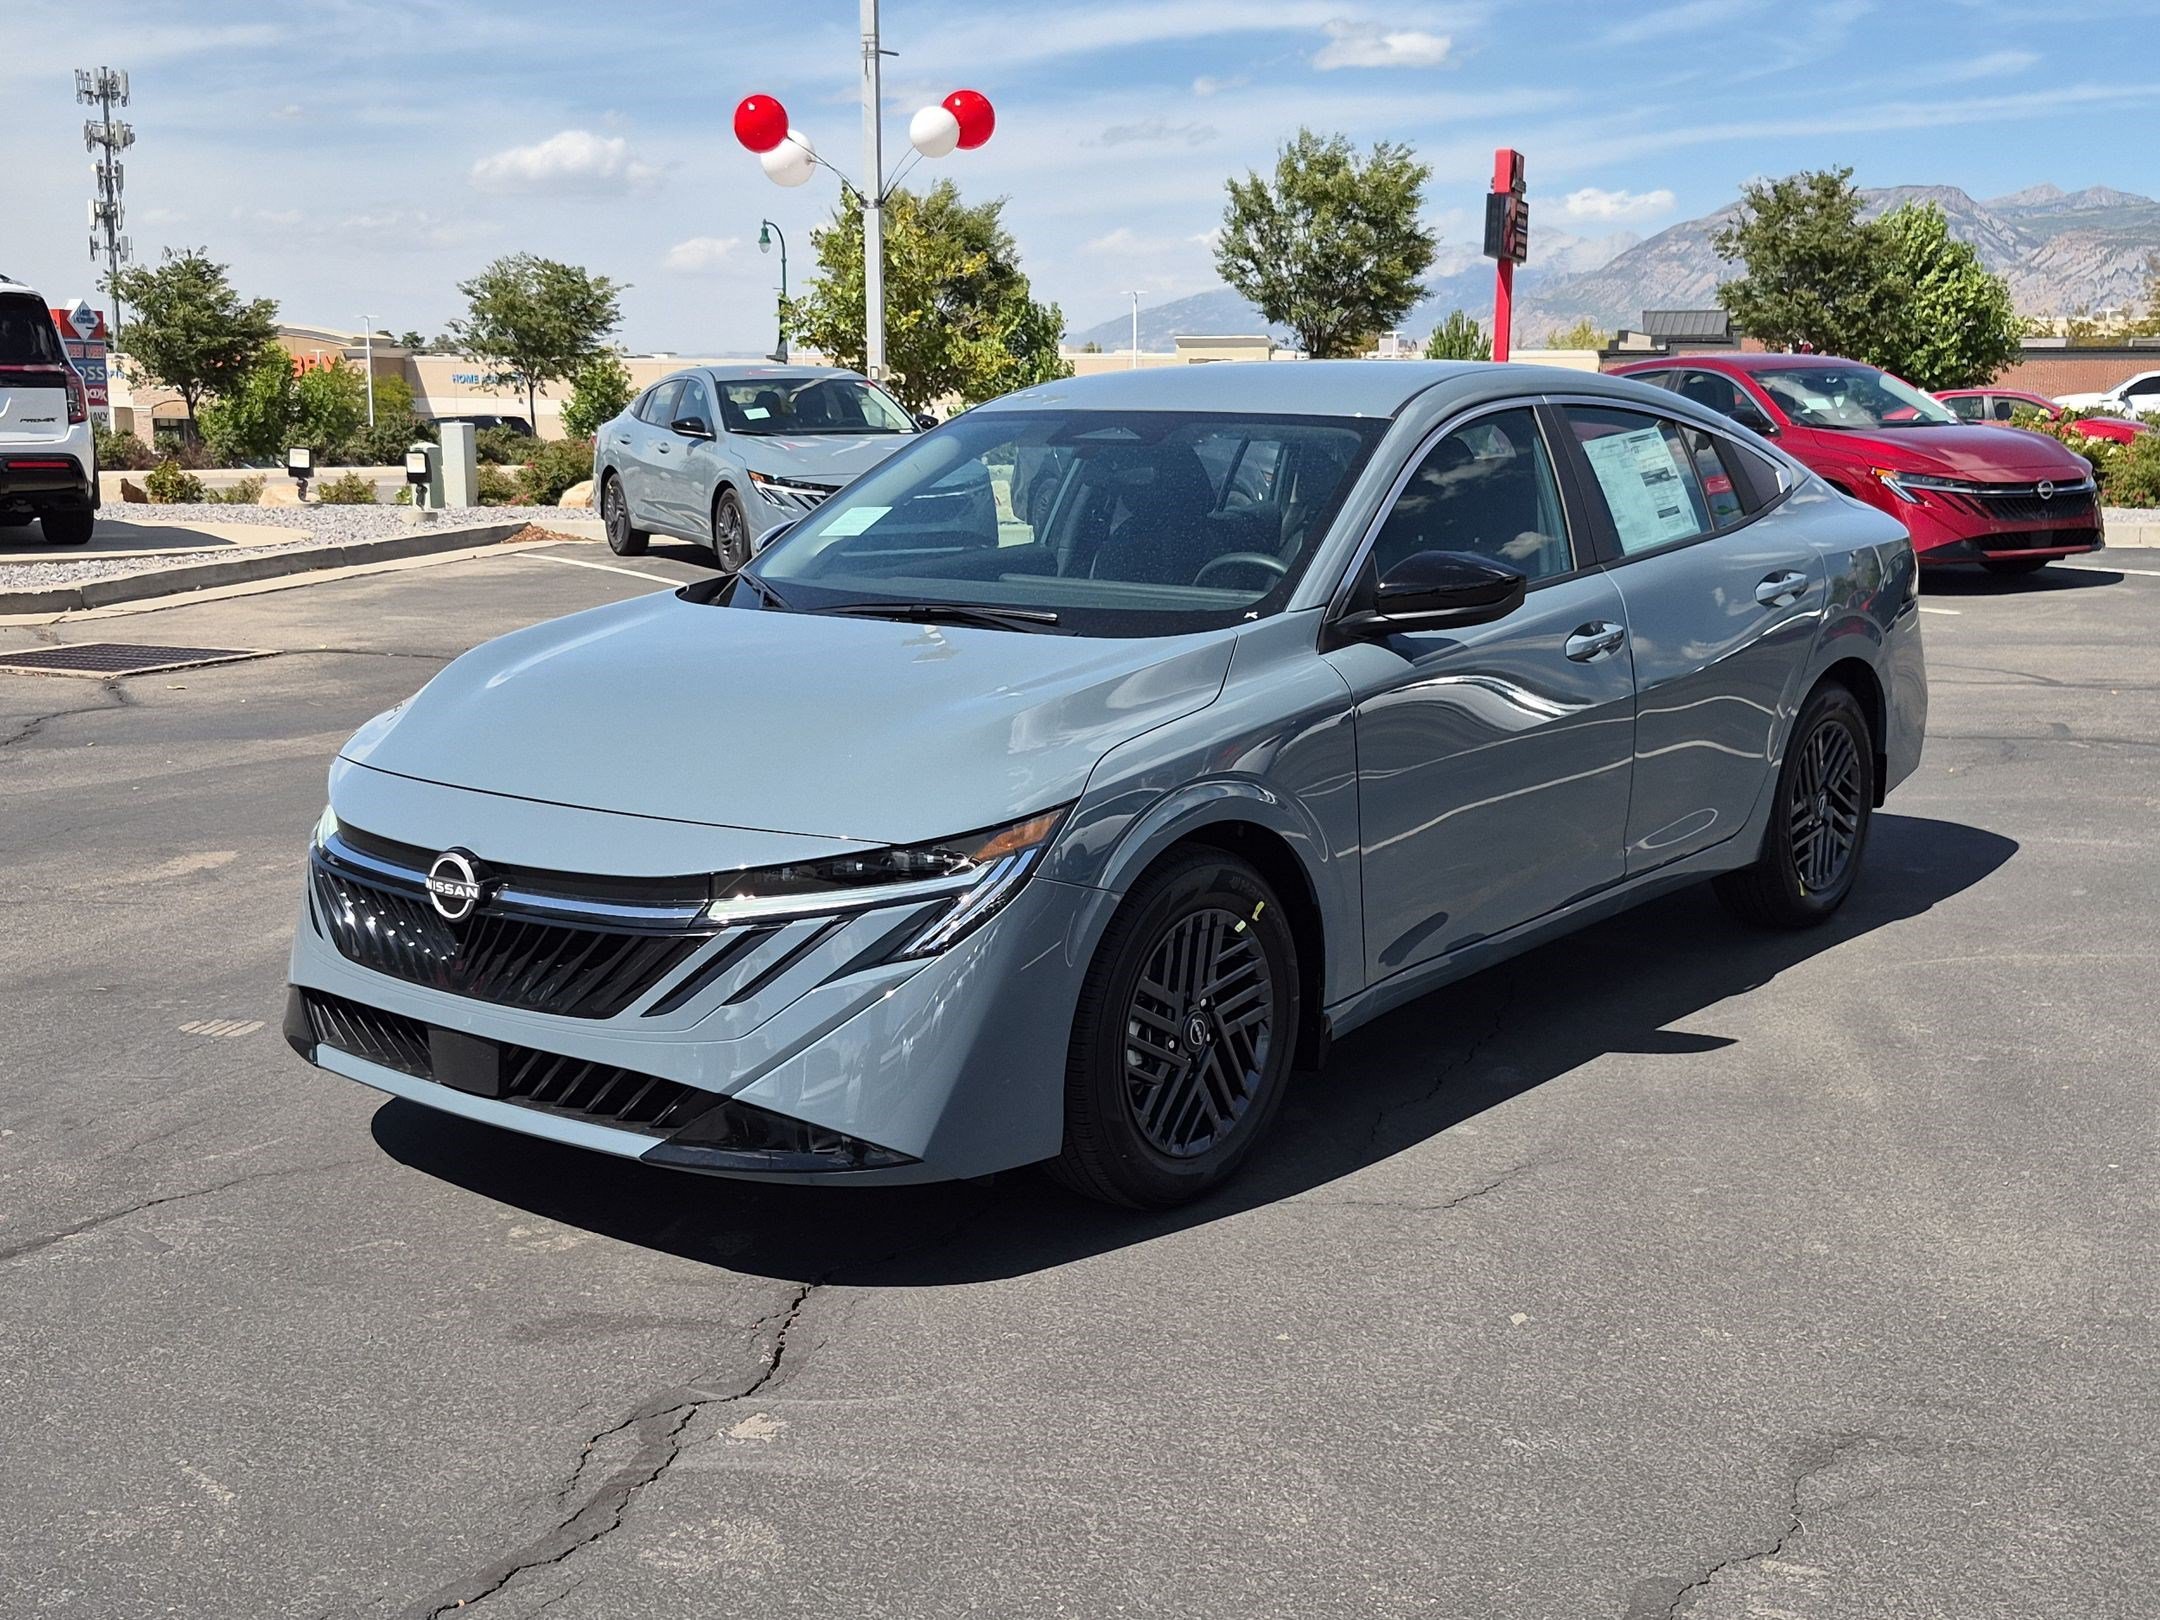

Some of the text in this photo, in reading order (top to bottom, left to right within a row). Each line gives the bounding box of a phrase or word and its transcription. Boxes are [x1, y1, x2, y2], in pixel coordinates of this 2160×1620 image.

[77, 366, 106, 381] OSS
[452, 373, 479, 384] HOME
[425, 877, 479, 899] NISSAN
